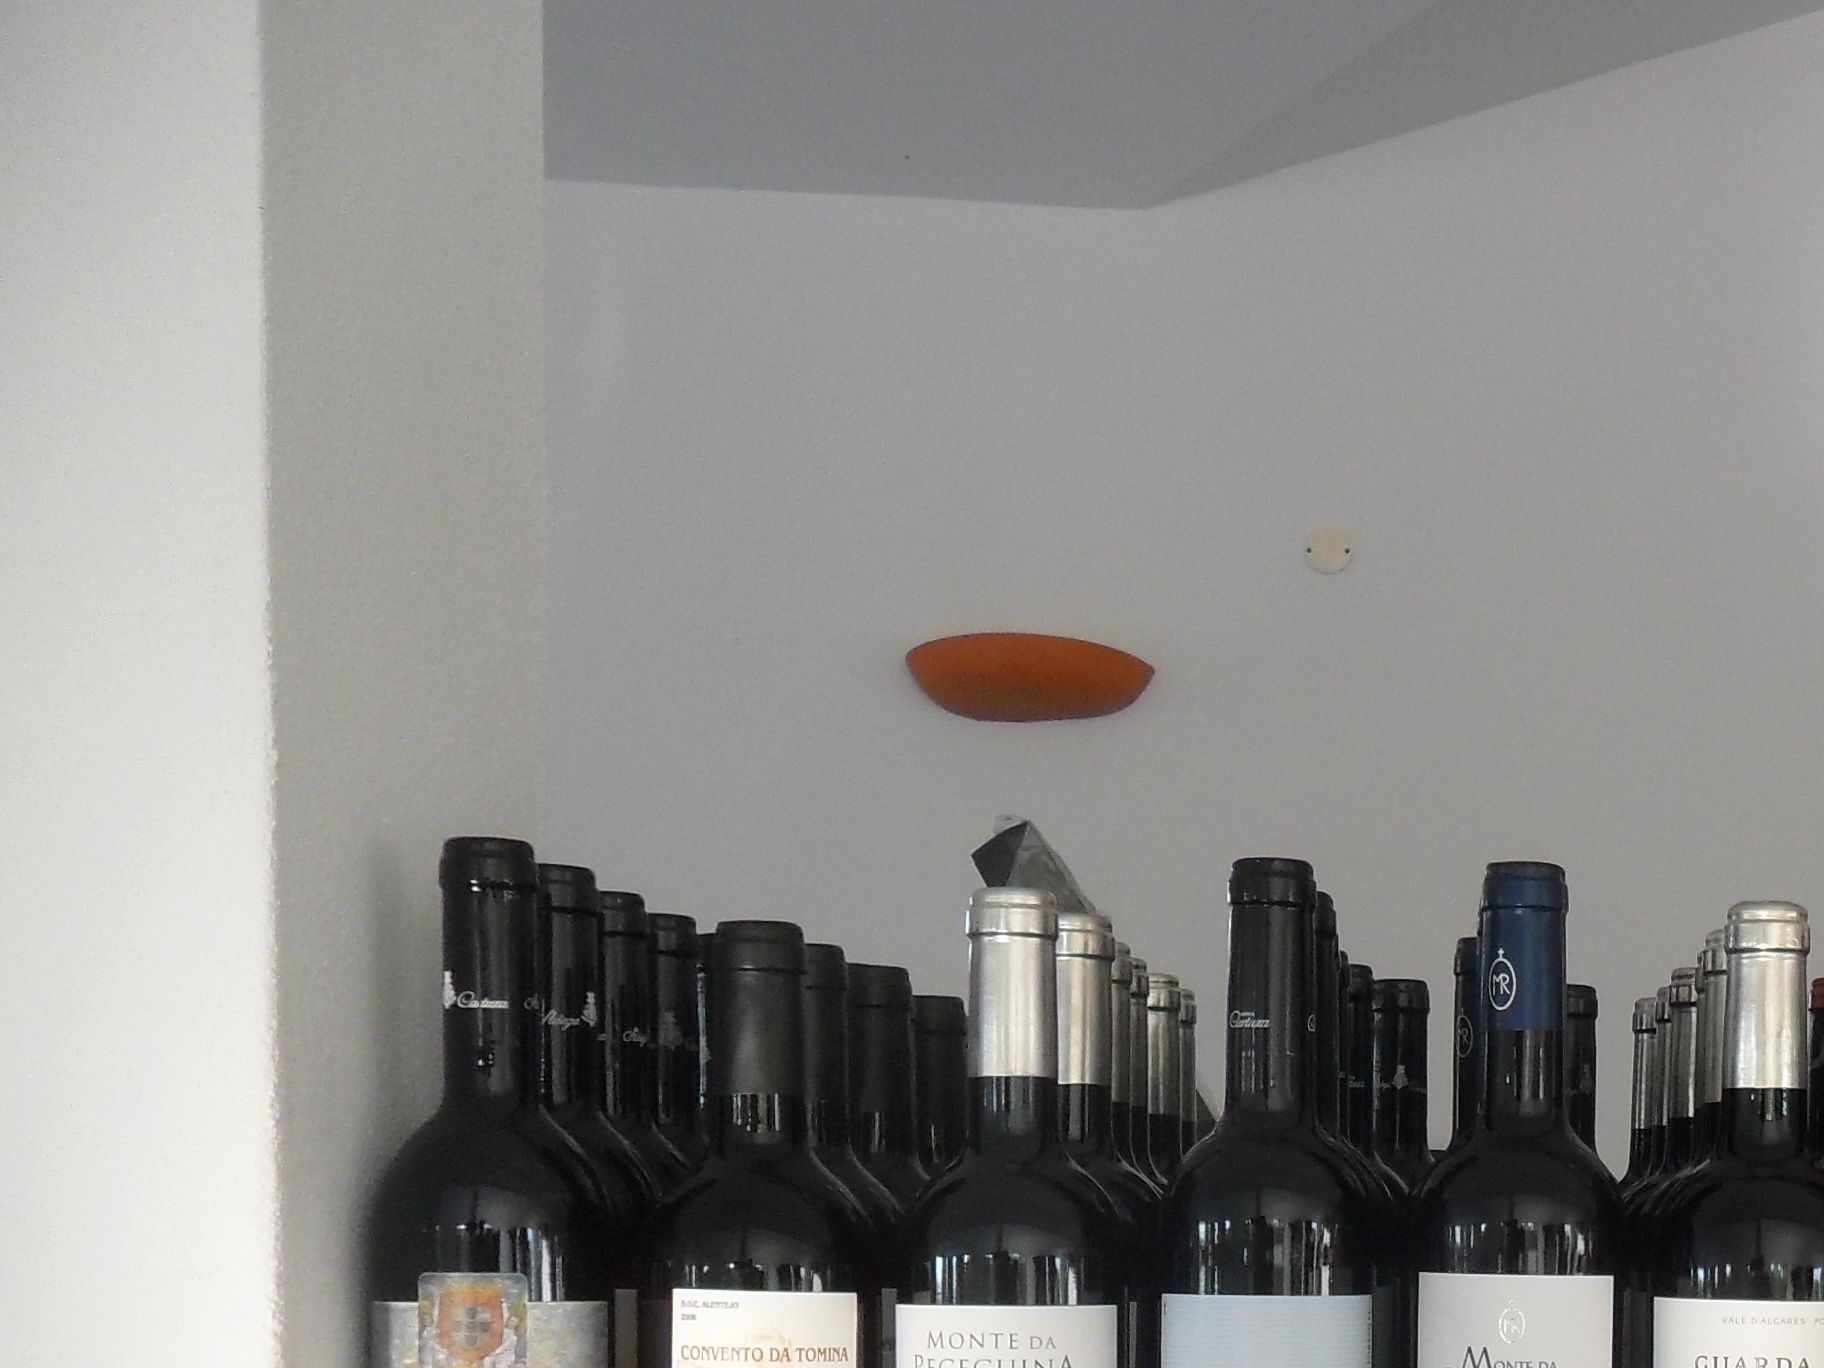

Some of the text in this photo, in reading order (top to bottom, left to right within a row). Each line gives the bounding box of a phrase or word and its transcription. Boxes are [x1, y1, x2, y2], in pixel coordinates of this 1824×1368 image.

[1722, 1317, 1746, 1325] VALE
[927, 1330, 1057, 1350] MONTE DA
[681, 1345, 849, 1363] CONVENTO DA TOMINA
